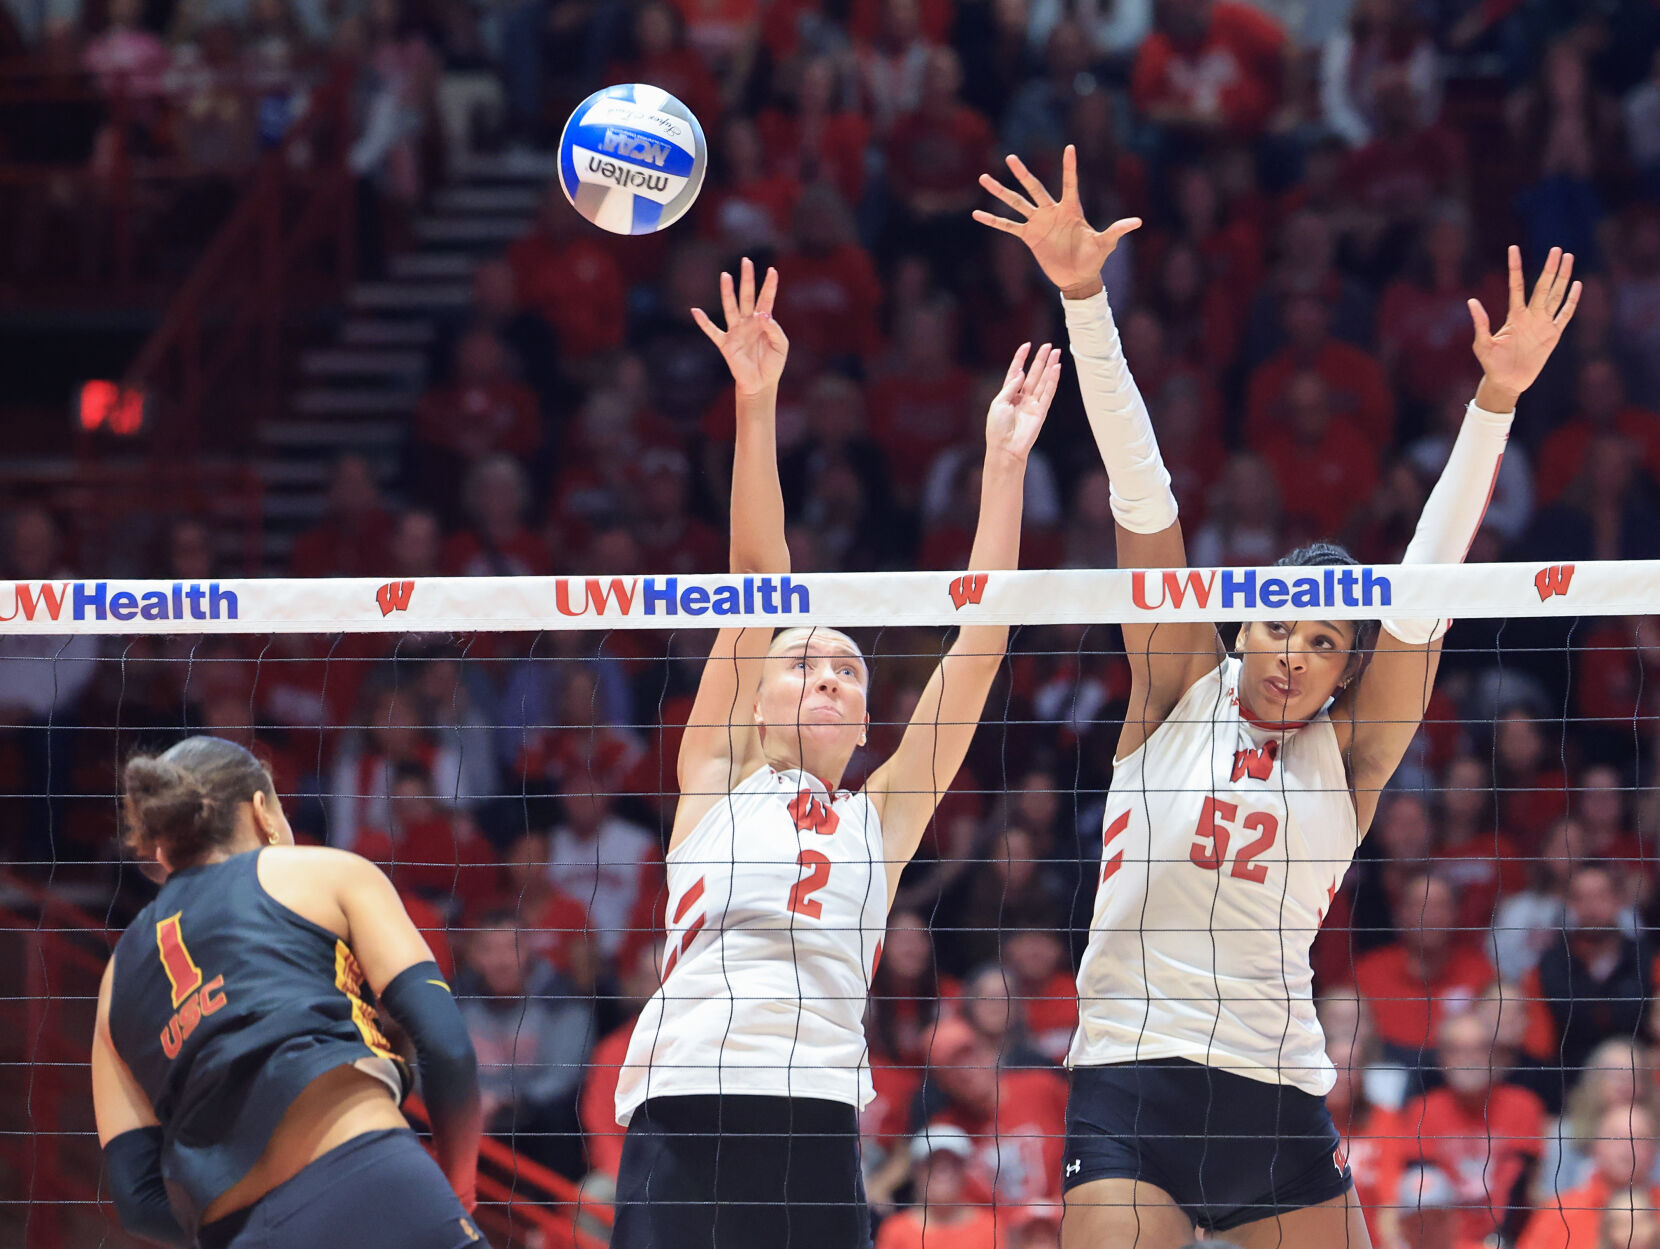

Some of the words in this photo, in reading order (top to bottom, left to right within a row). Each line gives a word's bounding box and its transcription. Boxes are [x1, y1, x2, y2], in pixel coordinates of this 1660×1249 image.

[588, 156, 669, 192] molten
[604, 128, 671, 167] NCAA
[1189, 795, 1279, 885] 52
[787, 849, 832, 920] 2
[156, 910, 202, 1010] 1
[160, 974, 227, 1059] USC
